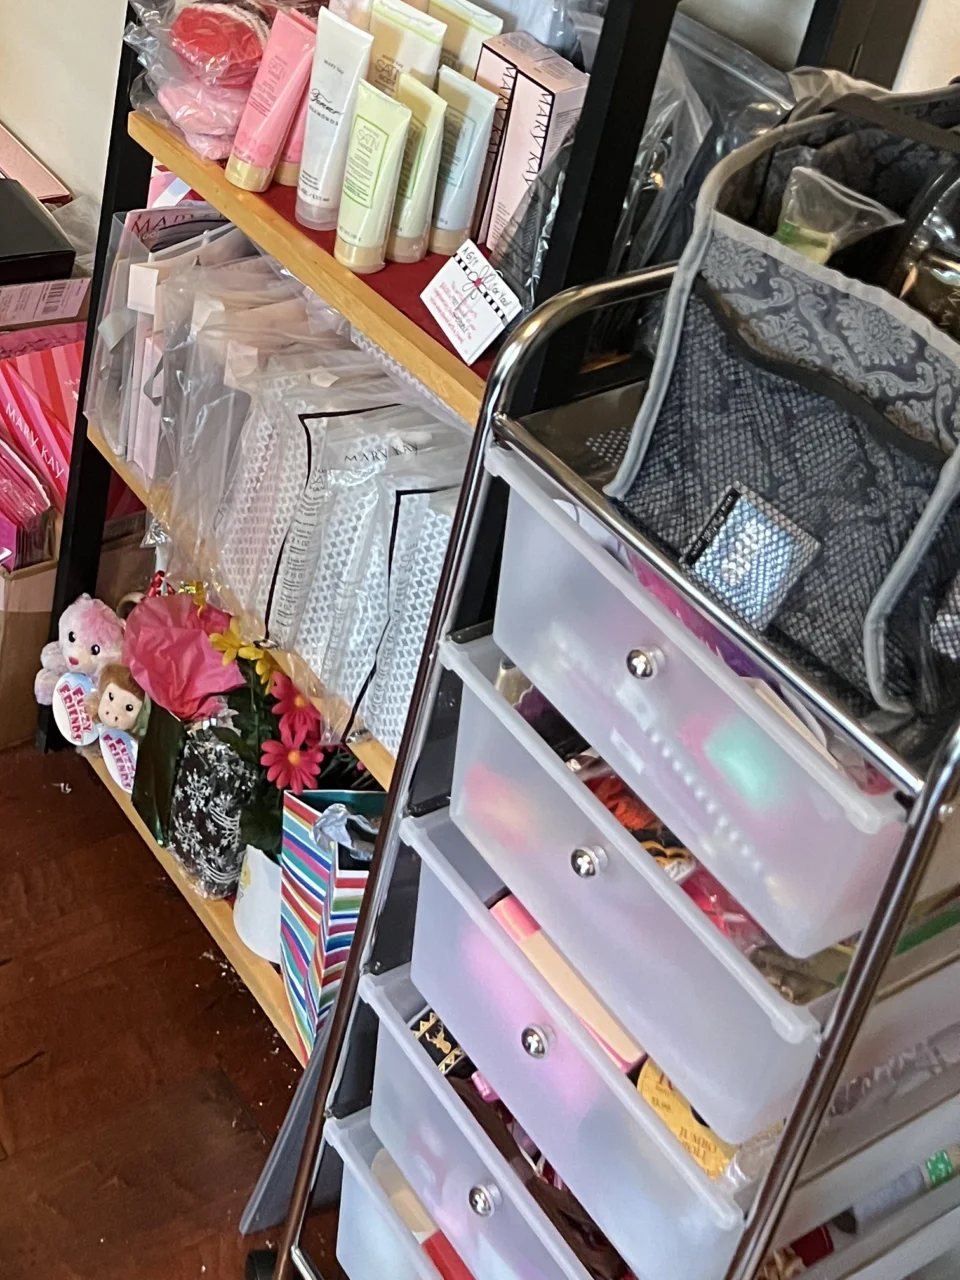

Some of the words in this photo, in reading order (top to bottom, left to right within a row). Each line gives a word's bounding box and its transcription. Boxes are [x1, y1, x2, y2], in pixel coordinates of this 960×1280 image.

[530, 93, 553, 149] MARY
[6, 402, 39, 448] MARY
[41, 445, 64, 479] KAY
[344, 449, 388, 463] MARY
[58, 683, 83, 741] FRIENDS
[72, 686, 93, 732] FUZZY
[102, 733, 132, 789] FRIENDS
[115, 737, 136, 779] FUZZ
